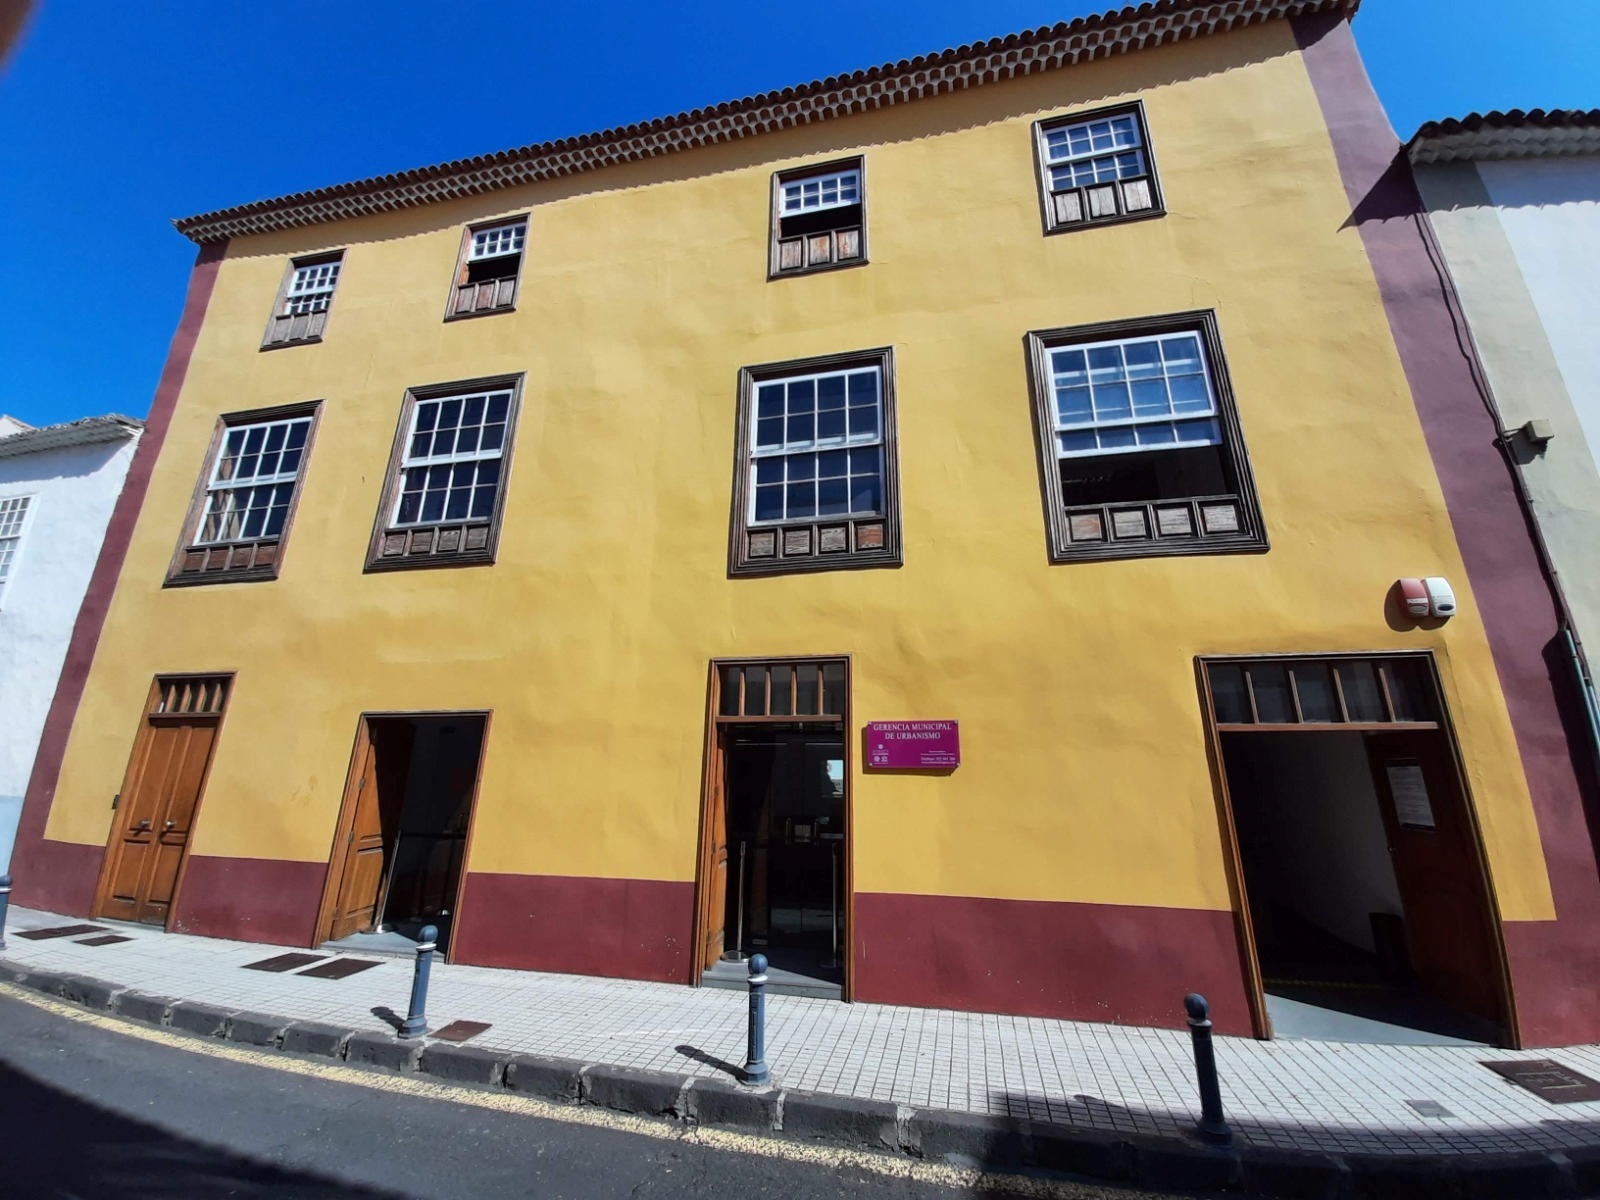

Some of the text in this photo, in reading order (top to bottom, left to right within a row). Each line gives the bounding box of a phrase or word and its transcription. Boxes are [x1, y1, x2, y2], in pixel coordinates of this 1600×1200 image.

[873, 723, 952, 731] GERENCIA MUNICIPAL
[885, 732, 941, 740] DE URBANISMO
